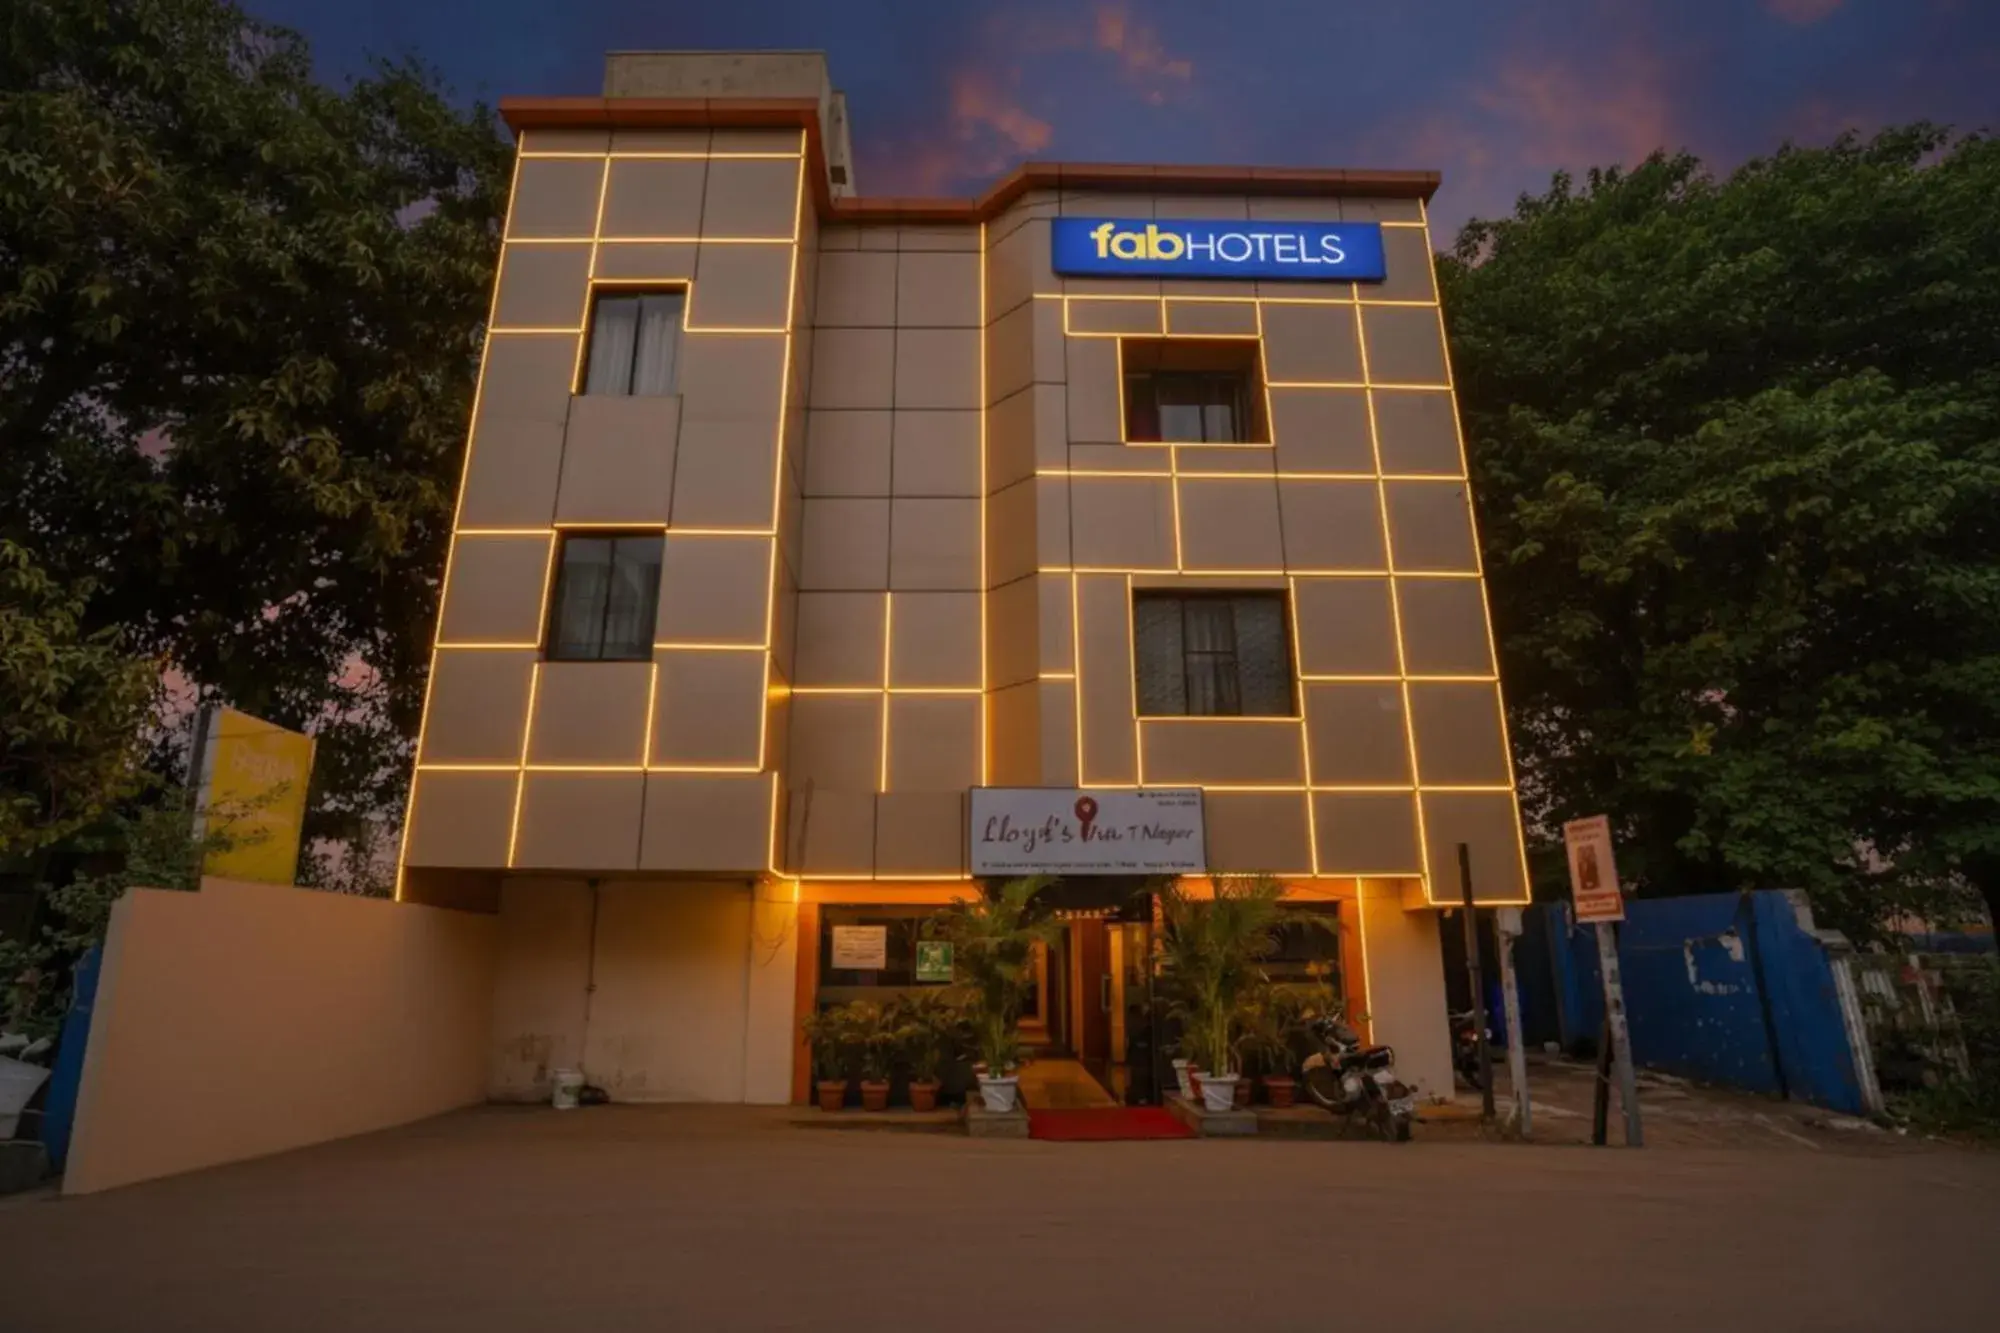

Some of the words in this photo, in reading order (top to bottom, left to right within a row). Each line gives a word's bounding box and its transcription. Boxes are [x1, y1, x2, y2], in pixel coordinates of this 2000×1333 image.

[981, 814, 1074, 854] Lloyd's
[1127, 825, 1139, 841] T
[1142, 822, 1194, 846] Nagar
